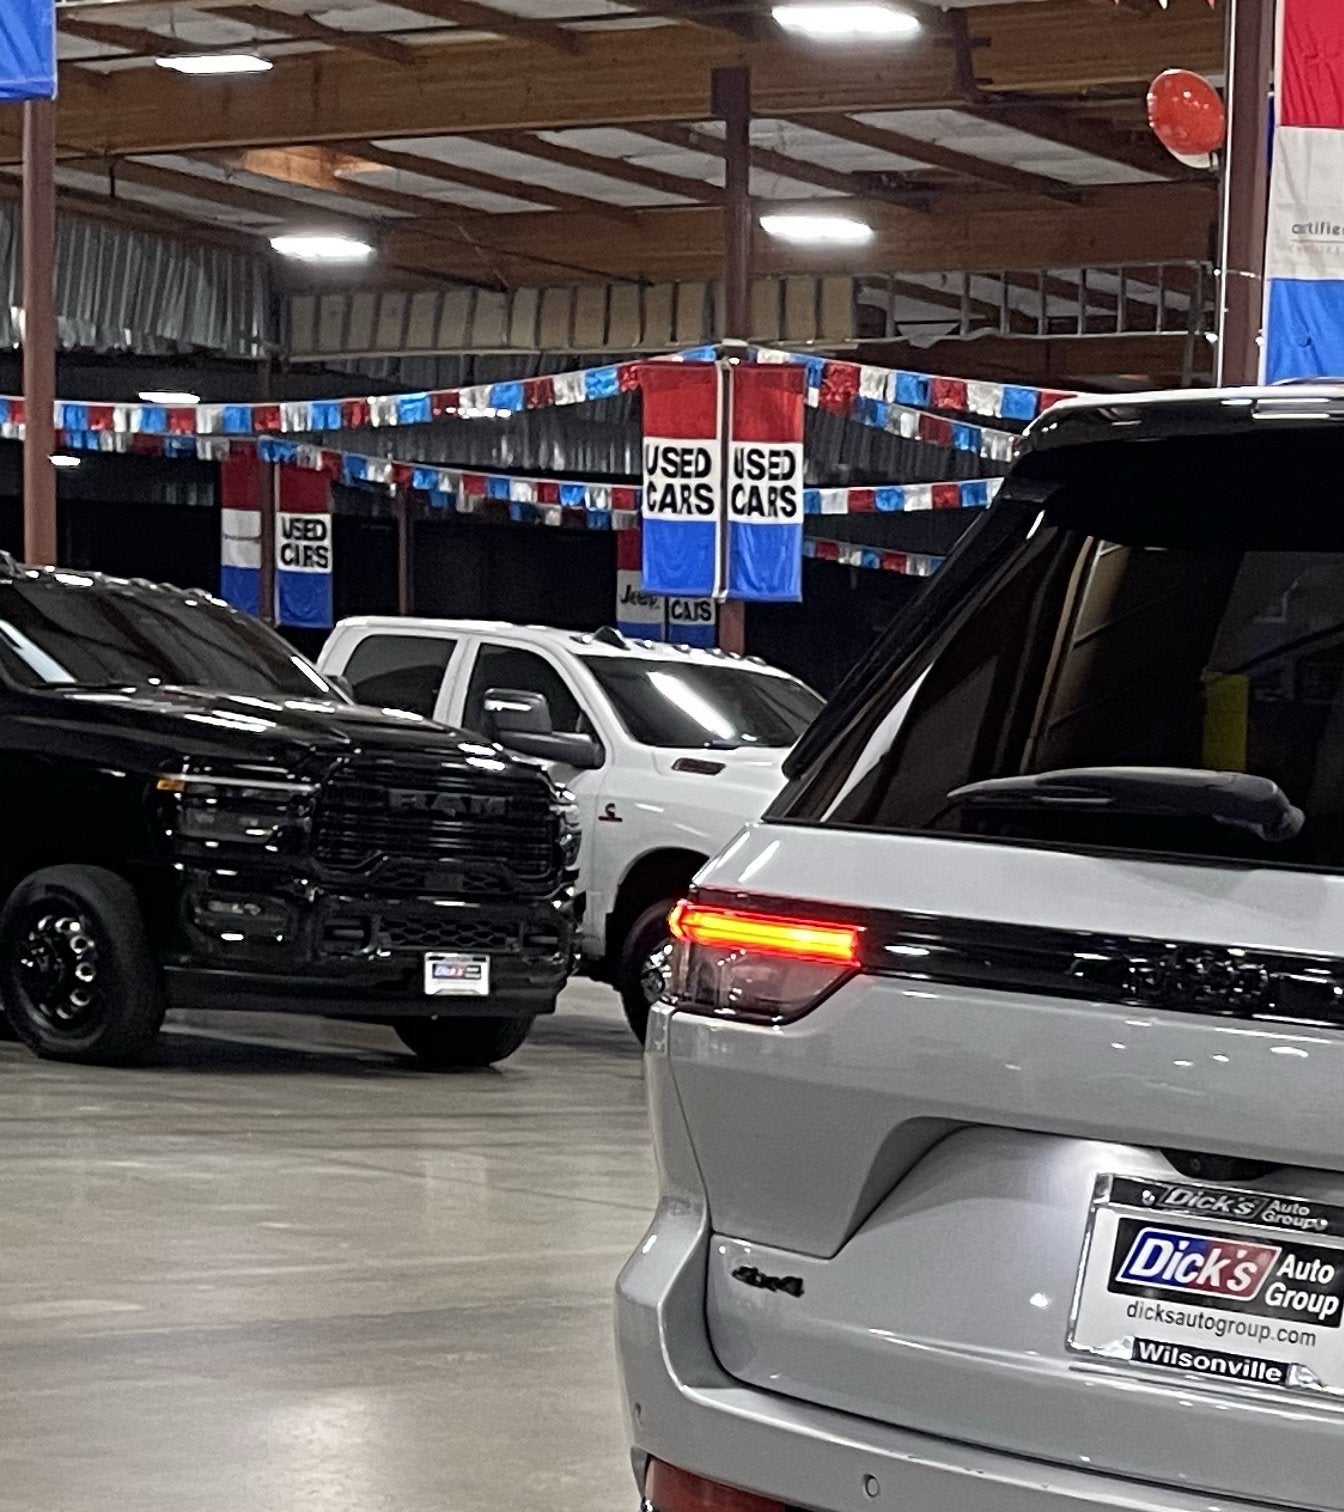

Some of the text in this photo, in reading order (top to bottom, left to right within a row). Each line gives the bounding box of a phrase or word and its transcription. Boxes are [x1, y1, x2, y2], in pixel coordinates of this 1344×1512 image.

[645, 444, 712, 478] USED
[733, 447, 796, 481] USED
[647, 481, 715, 515] CARS
[731, 485, 797, 518] CARS
[1165, 1188, 1310, 1216] Dick's Auto
[1261, 1210, 1318, 1230] Group
[1128, 1237, 1335, 1293] Dick's Auto
[1265, 1282, 1340, 1321] Group
[1126, 1300, 1317, 1347] dicksautogroup.com
[1138, 1340, 1283, 1383] Wilsonville
